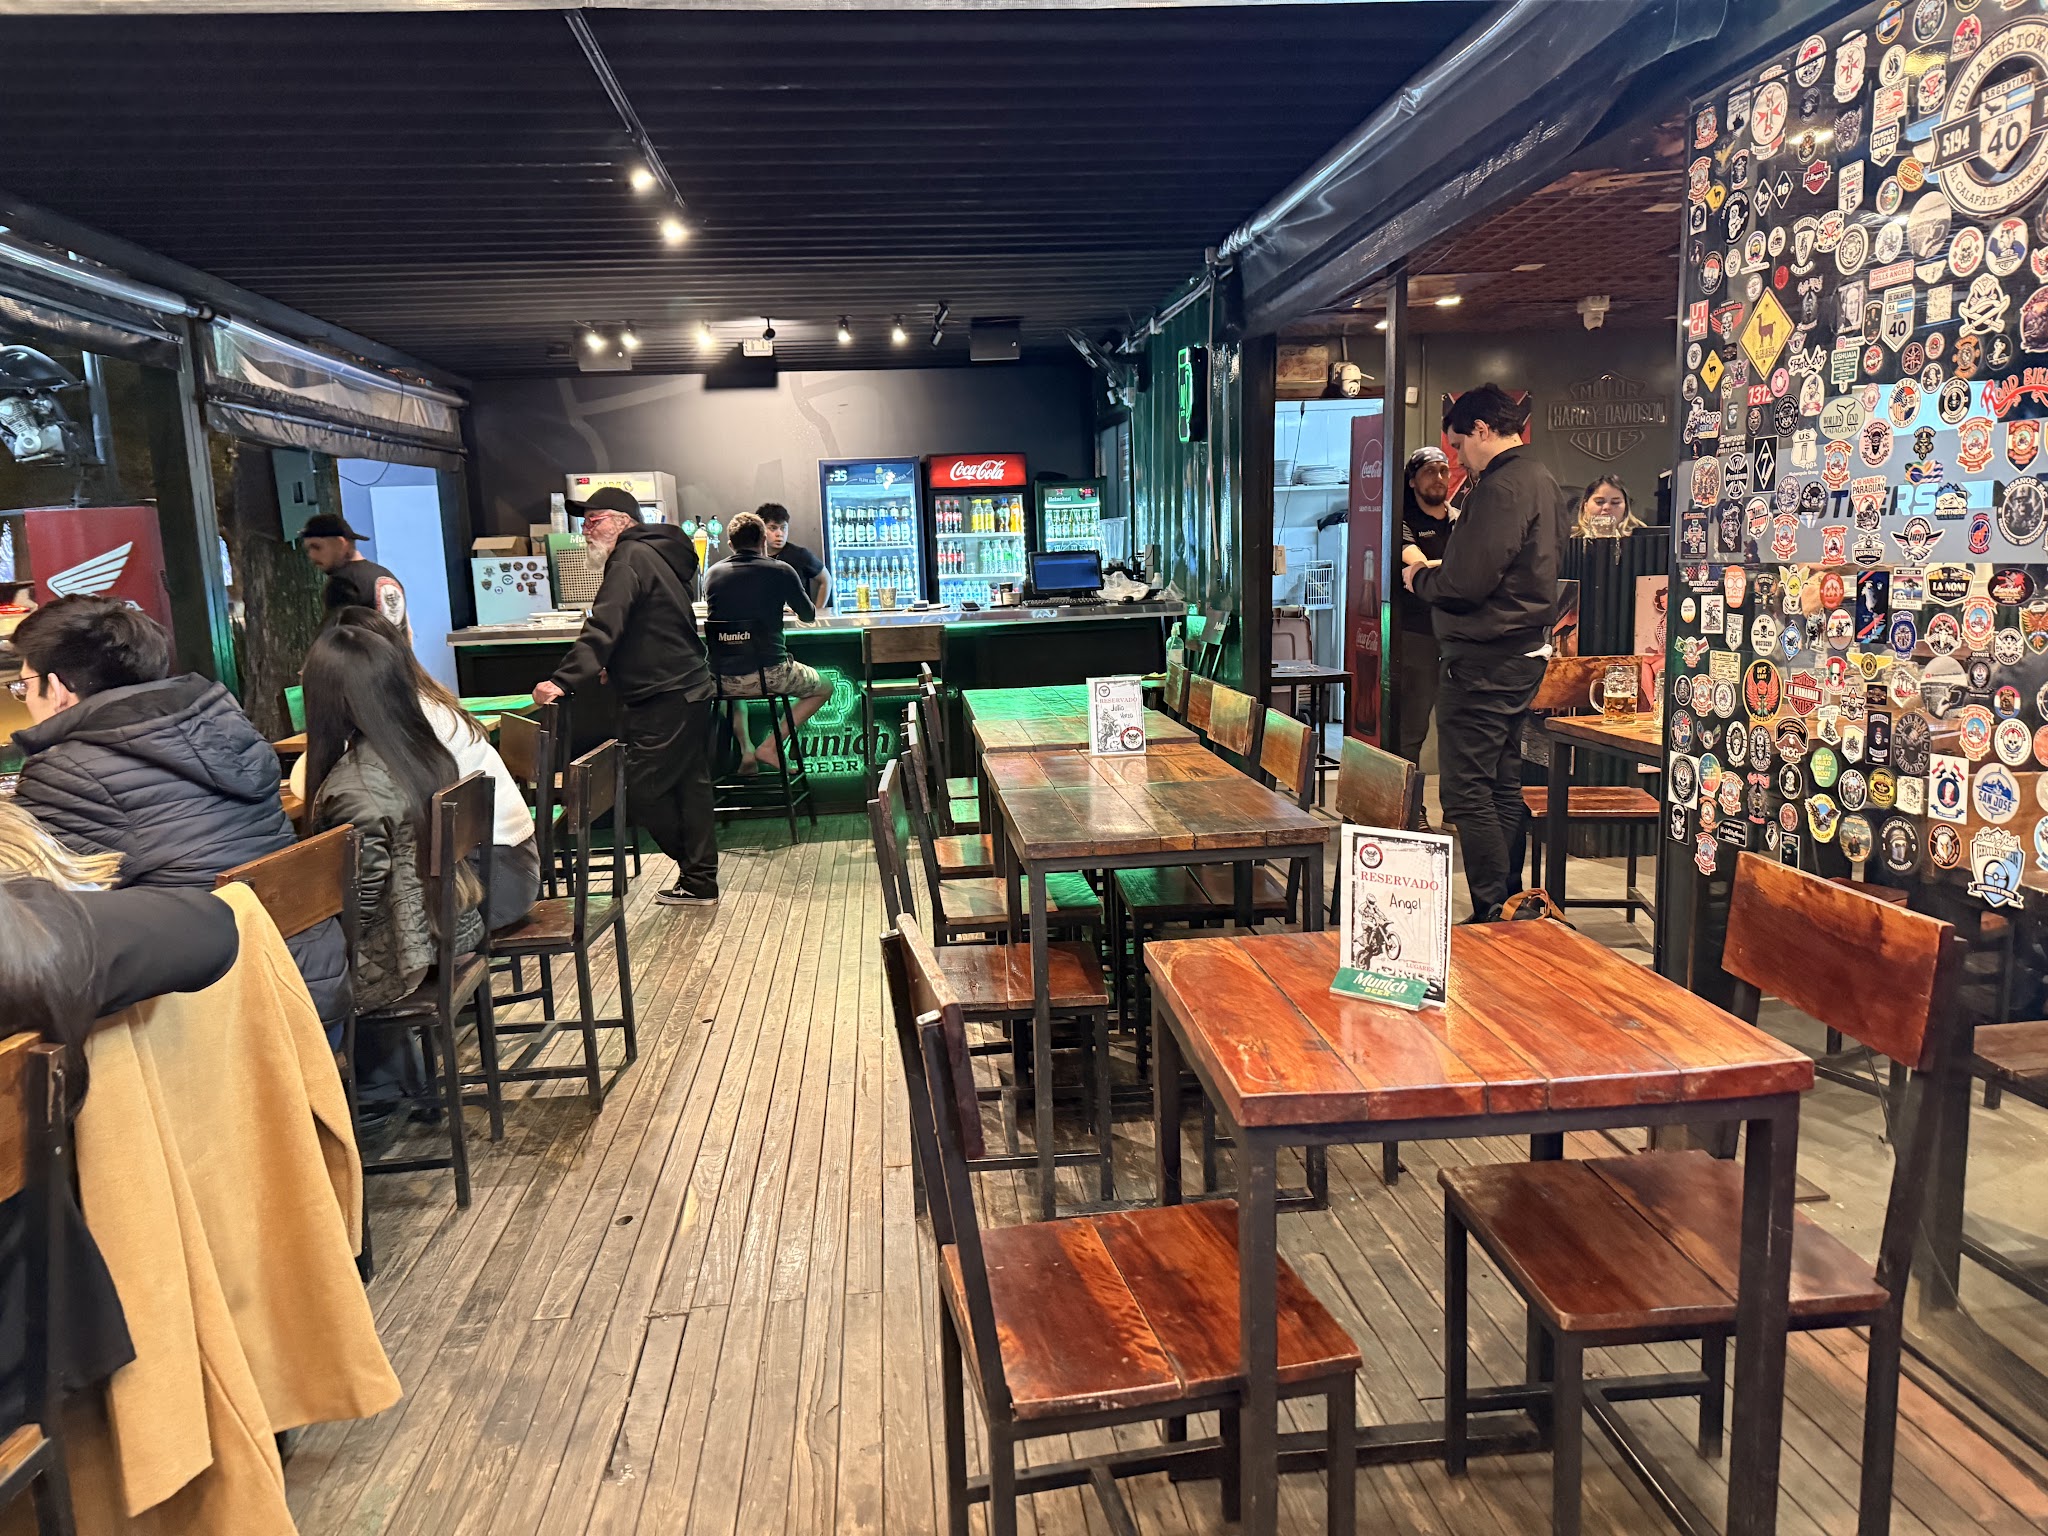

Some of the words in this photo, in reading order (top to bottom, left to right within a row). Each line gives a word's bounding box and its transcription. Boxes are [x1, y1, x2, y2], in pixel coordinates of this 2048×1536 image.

[1954, 62, 1987, 115] RUTA
[1984, 70, 2032, 101] ARGENTINA
[1997, 112, 2014, 126] RUTA
[1873, 126, 1896, 140] BUENAS
[1987, 121, 2022, 156] 40
[1872, 135, 1896, 149] RUTAS
[1941, 125, 1971, 157] 5194
[1777, 182, 1790, 197] 16
[1949, 166, 1958, 181] EL
[1955, 180, 1999, 207] CALAFATE
[1844, 196, 1856, 210] 15
[1889, 268, 1911, 279] ANGELS
[1691, 302, 1707, 320] UT
[1888, 320, 1907, 338] 40
[1834, 351, 1858, 361] USHUAIA
[1579, 379, 1639, 398] MOTOR
[1981, 370, 2019, 416] ROAD
[1553, 402, 1666, 427] HARLEY-DAVIDSON
[1700, 414, 1721, 424] MOTO
[1798, 432, 1811, 440] US
[1824, 425, 1857, 434] PATAGONIA
[1576, 430, 1638, 457] CYCLES
[1719, 434, 1746, 444] SIMPSON
[950, 460, 1007, 481] Coca-Cola
[1852, 483, 1886, 495] PARAGUAY
[2003, 477, 2038, 496] INSANOS
[1932, 582, 1943, 591] LA
[1945, 582, 1967, 592] NONI
[718, 631, 751, 641] Munich
[1729, 634, 1738, 644] 64
[1100, 696, 1137, 704] RESERVADO
[1978, 790, 1993, 804] SAN
[1993, 797, 2013, 813] JOSE
[1977, 828, 1995, 843] San
[1361, 871, 1439, 891] RESERVADO
[1389, 893, 1421, 915] Angel
[1405, 963, 1435, 972] LUGARES
[1353, 972, 1408, 994] Munich
